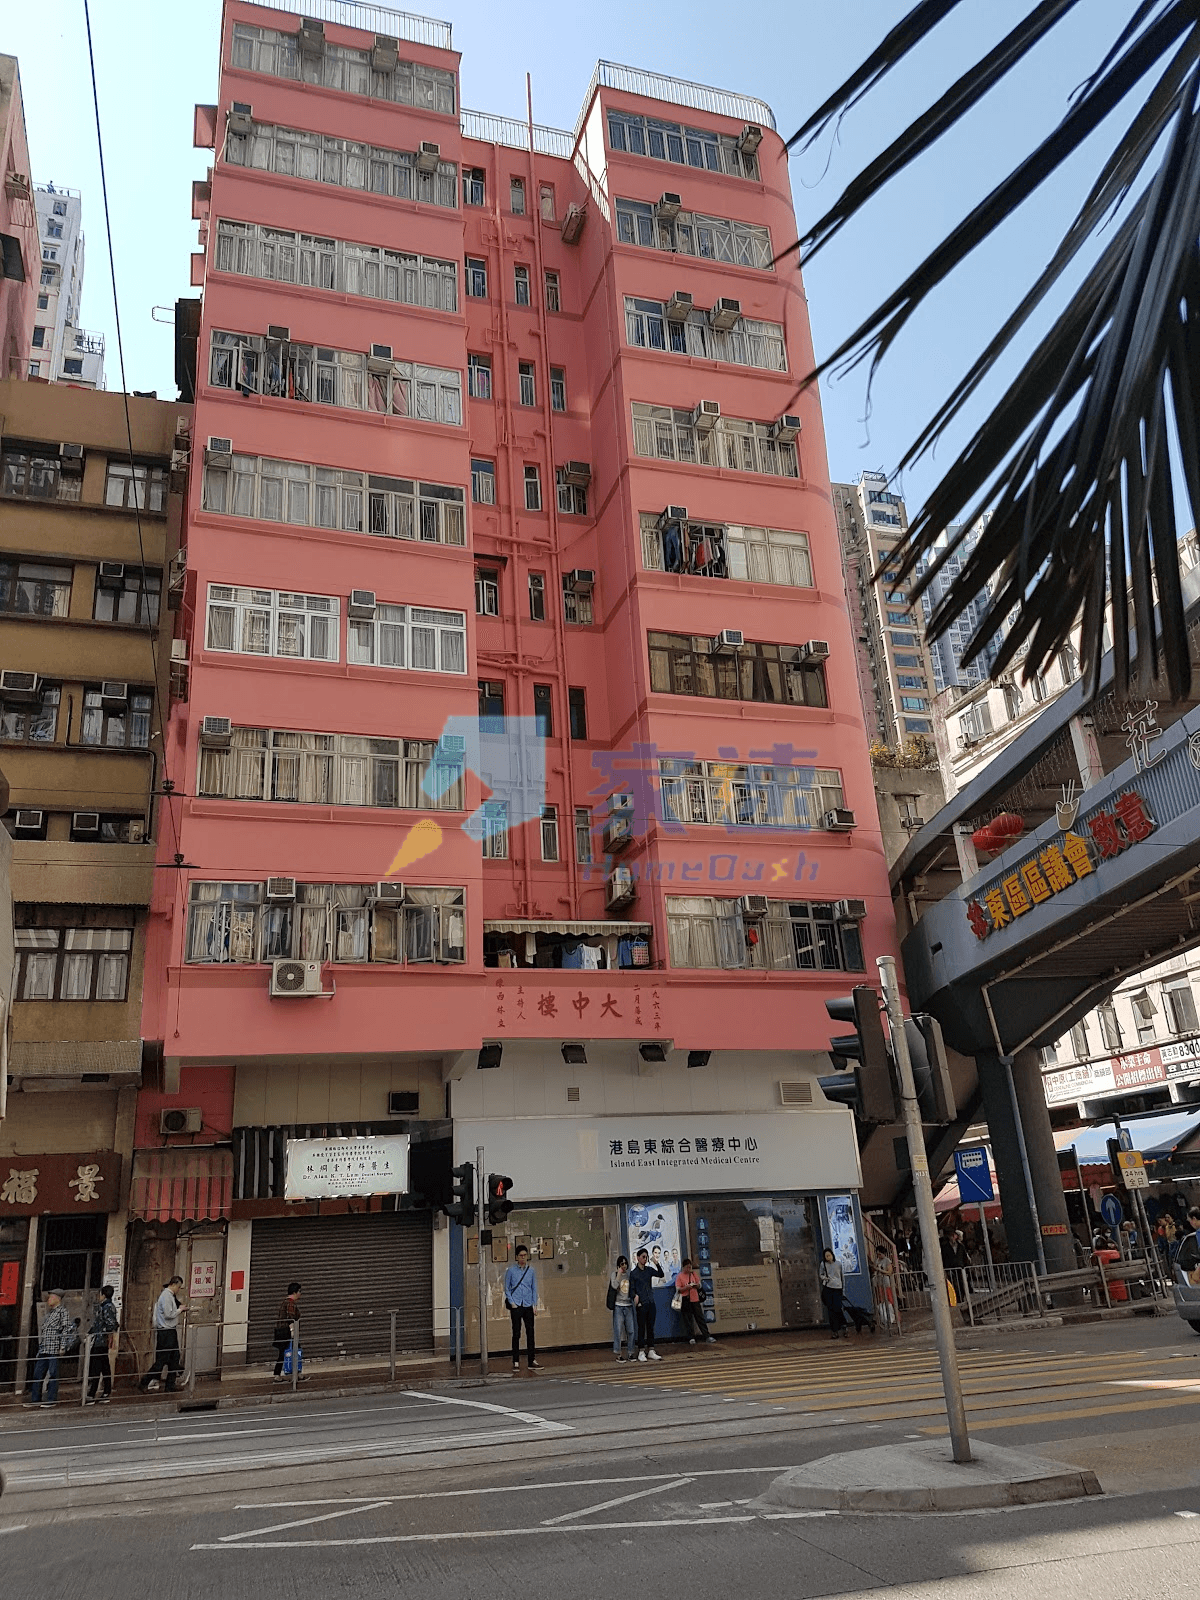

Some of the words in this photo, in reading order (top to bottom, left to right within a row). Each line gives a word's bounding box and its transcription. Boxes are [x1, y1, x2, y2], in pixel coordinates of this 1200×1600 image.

[1121, 700, 1167, 774] 花
[651, 983, 662, 1032] 一九六三年
[609, 1136, 758, 1155] 港島東綜合醫療中心
[610, 1159, 635, 1168] Island
[638, 1158, 655, 1167] East
[657, 1157, 699, 1167] Integrated
[700, 1156, 732, 1165] Medical
[733, 1155, 760, 1164] Centre
[1129, 1177, 1145, 1187] 全日
